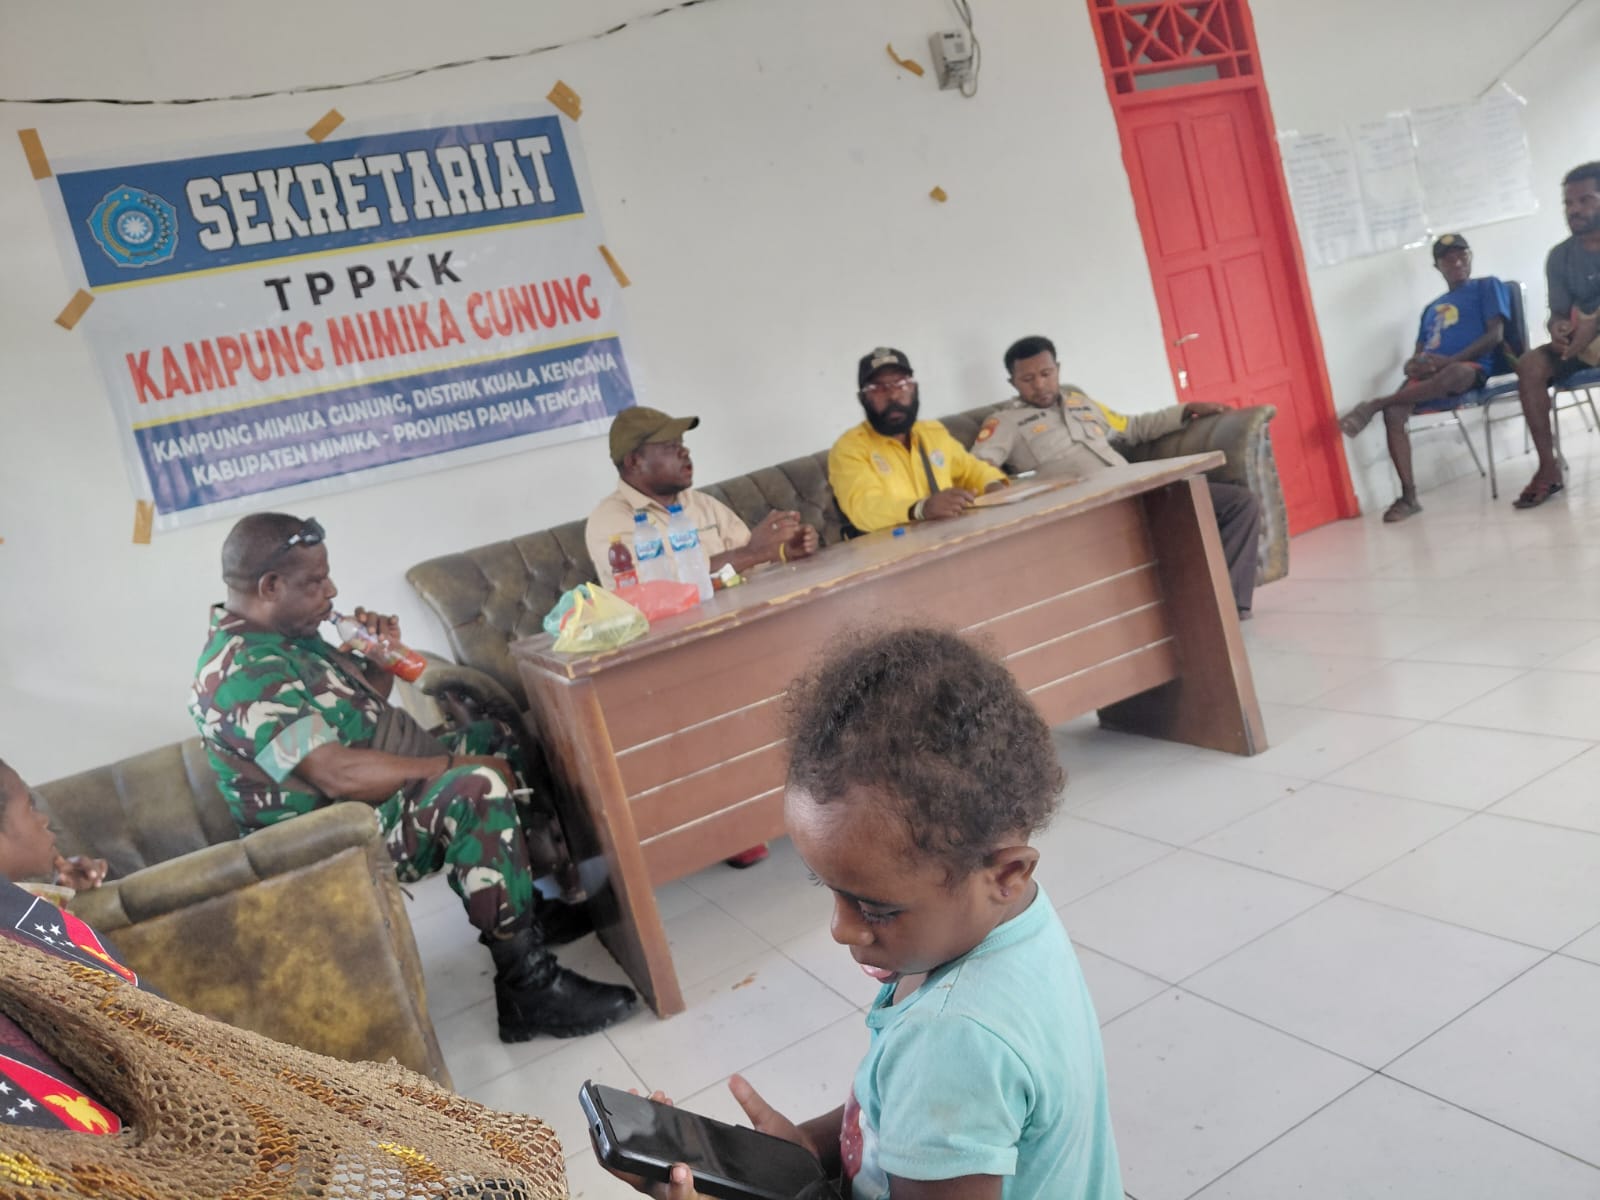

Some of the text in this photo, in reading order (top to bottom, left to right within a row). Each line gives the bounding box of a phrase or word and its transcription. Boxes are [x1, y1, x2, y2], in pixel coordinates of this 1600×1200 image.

[185, 134, 559, 251] SEKRETARIAT
[126, 274, 602, 404] KAMPUNG MIMIKA GUNUNG
[153, 353, 618, 463] KAMPUNG MIMIKA GUNUNG, DISTRIK KUALA KENCANA
[192, 448, 308, 487] KABUPATEN
[311, 430, 380, 461] MIMIKA
[393, 410, 476, 443] PROVINSI
[476, 398, 535, 425] PAPUA
[533, 384, 603, 414] TENGAH
